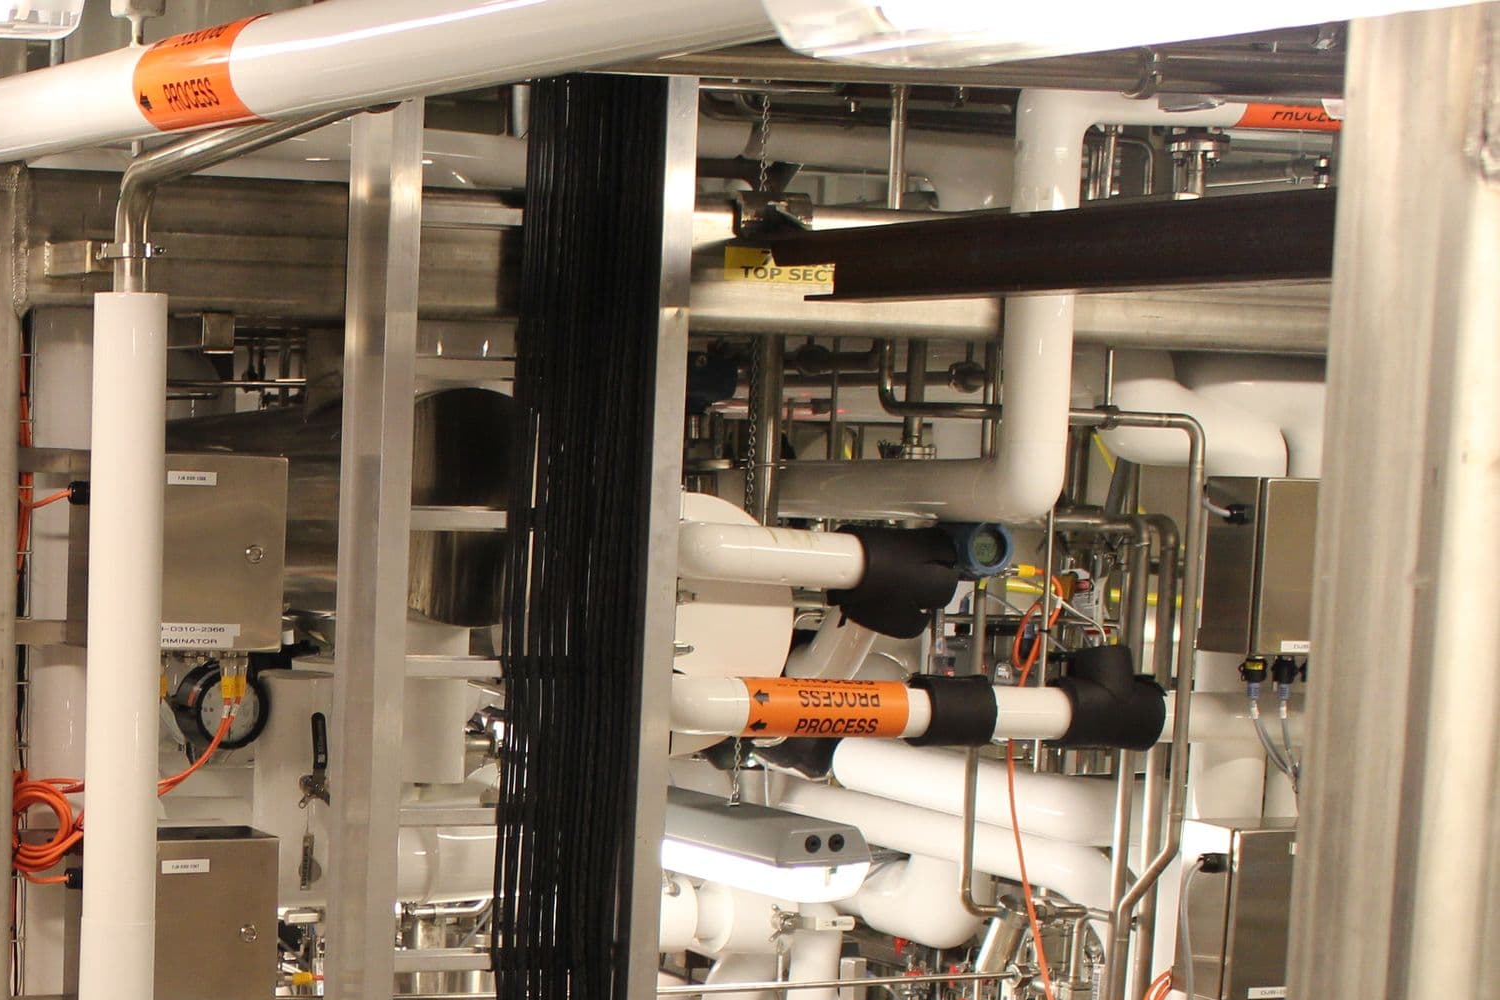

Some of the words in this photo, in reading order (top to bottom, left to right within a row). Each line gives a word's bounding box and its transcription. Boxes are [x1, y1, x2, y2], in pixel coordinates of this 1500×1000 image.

[162, 77, 220, 112] PROCESS
[741, 266, 782, 279] TOP
[798, 690, 881, 708] PROCESS
[794, 718, 879, 734] PROCESS
